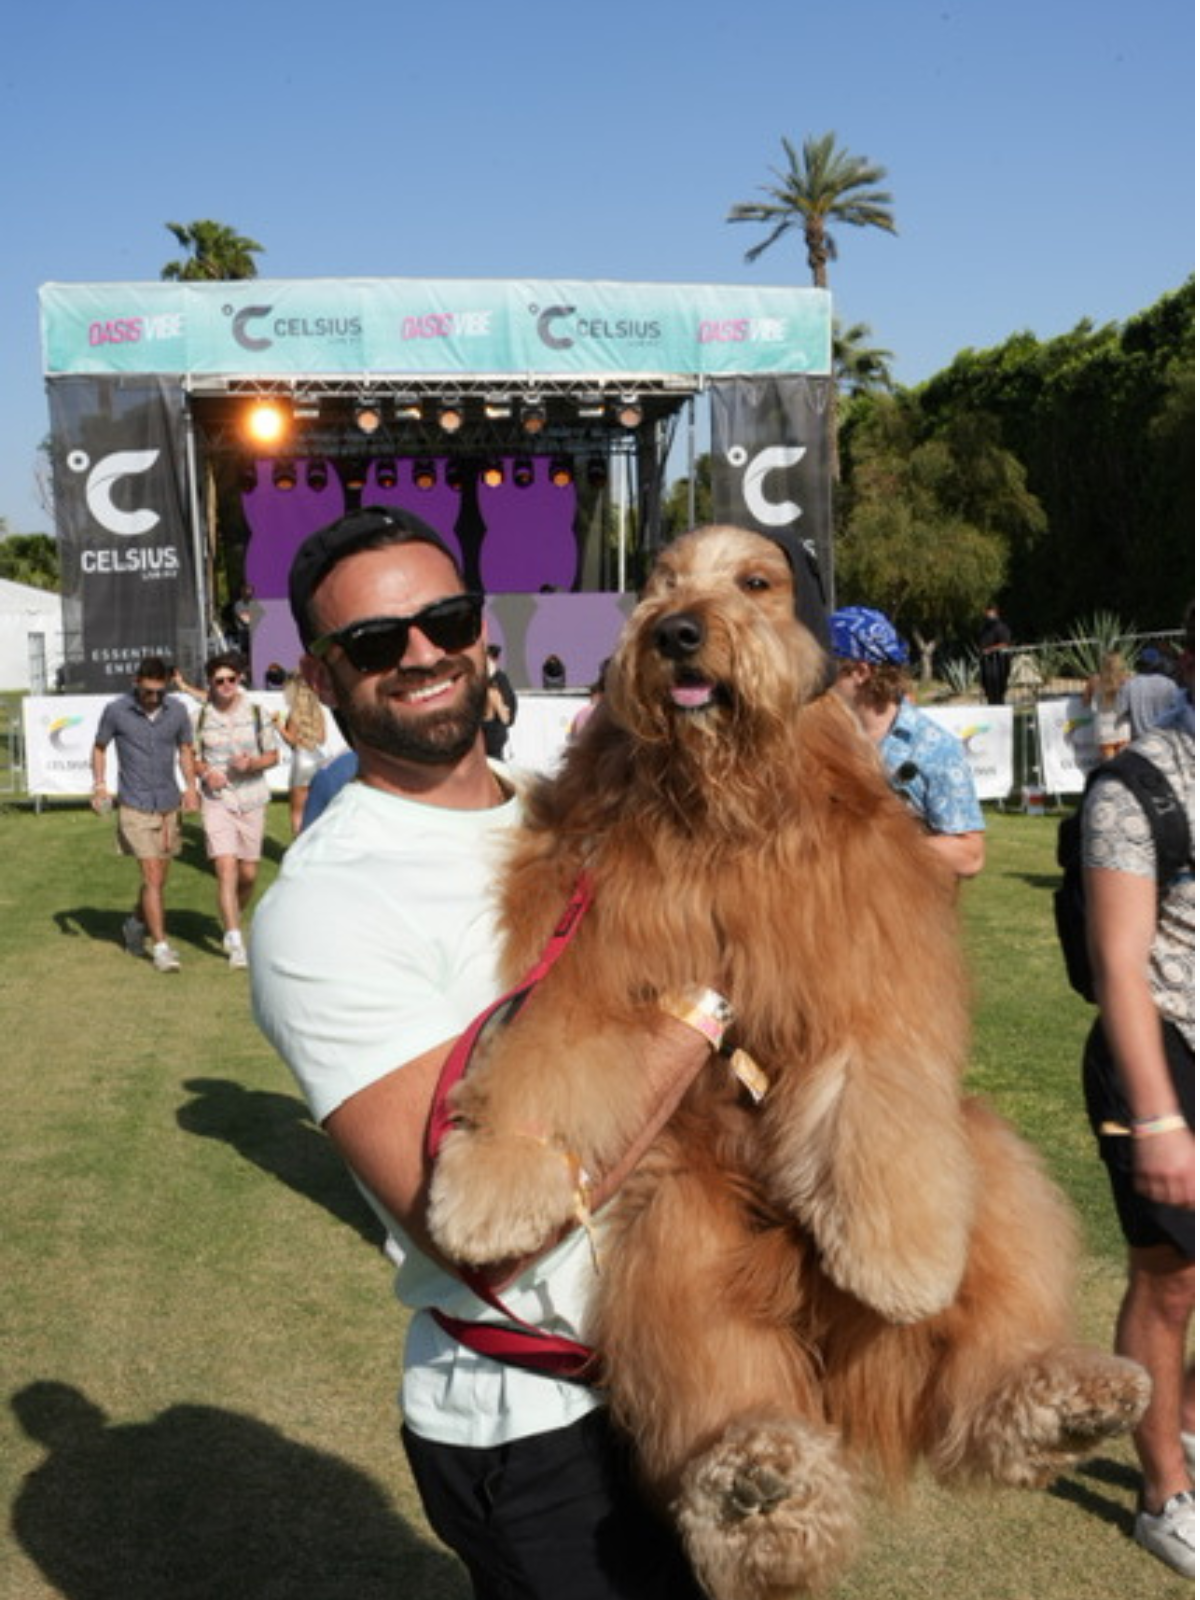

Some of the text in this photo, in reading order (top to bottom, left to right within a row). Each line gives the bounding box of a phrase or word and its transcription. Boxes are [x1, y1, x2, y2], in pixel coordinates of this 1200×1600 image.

[274, 318, 362, 337] CELSIUS
[577, 319, 661, 339] CELSIUS
[81, 546, 179, 573] CELSIUS
[91, 646, 172, 661] ESSENTIAL
